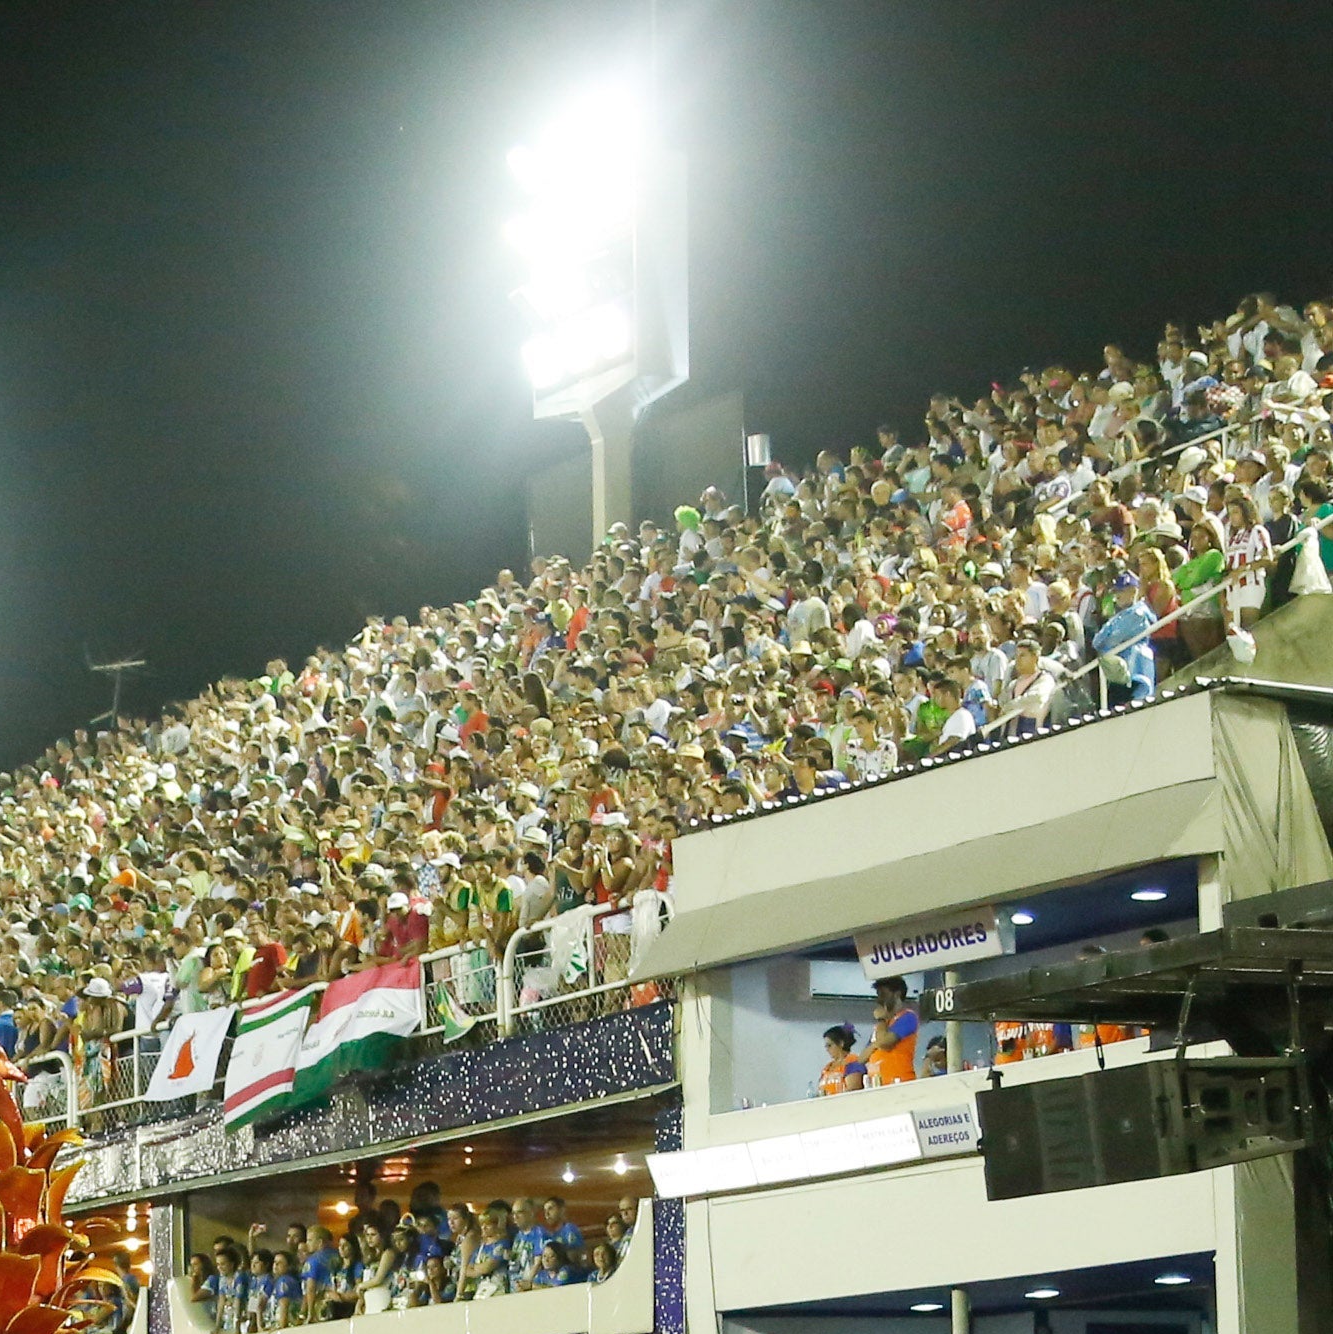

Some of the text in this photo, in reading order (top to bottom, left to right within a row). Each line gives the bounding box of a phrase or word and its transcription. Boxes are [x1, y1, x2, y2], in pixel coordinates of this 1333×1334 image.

[871, 922, 987, 965] JULGADORES
[935, 989, 954, 1013] 08
[918, 1113, 971, 1130] ALEGORIAS E
[928, 1131, 970, 1146] ADEREÇOS
